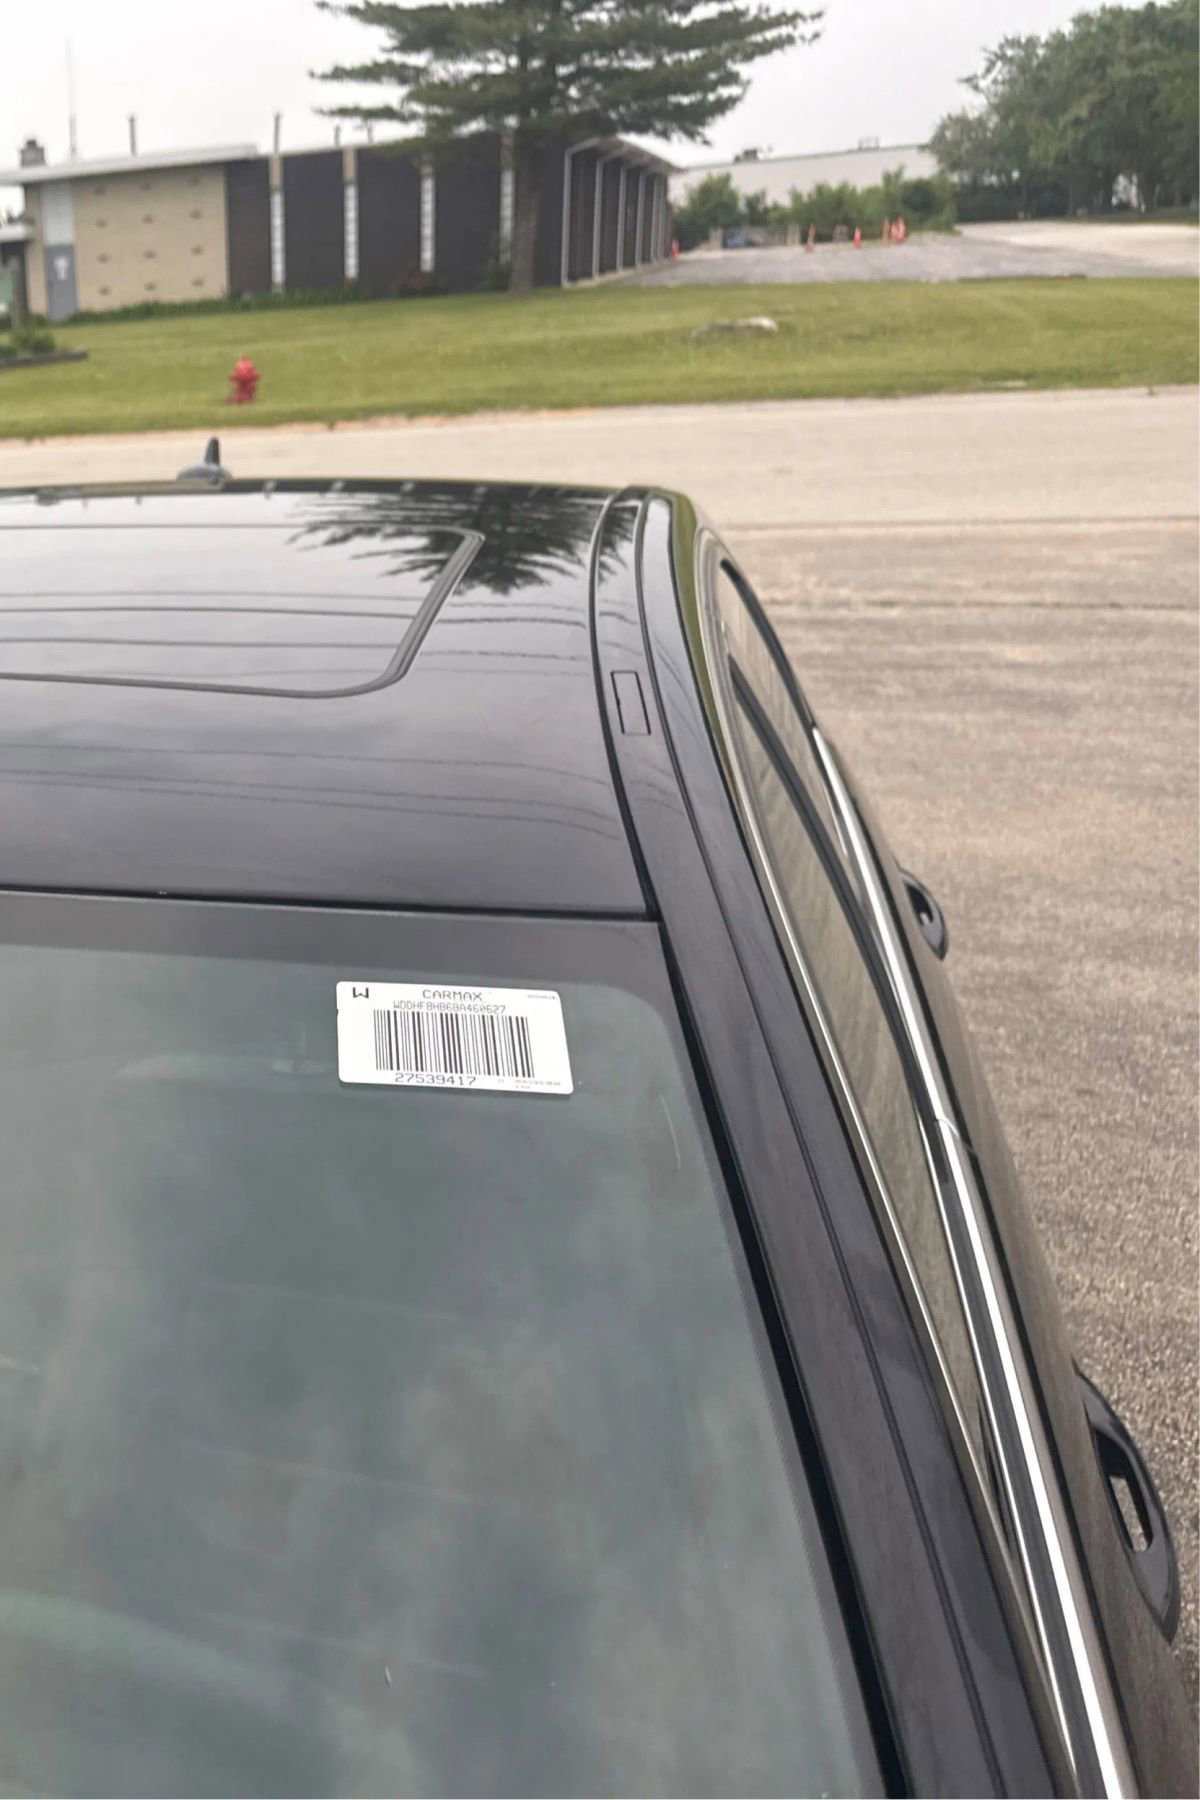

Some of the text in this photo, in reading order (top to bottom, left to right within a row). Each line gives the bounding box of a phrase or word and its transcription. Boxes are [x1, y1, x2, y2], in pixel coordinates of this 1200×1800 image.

[352, 987, 369, 998] W
[422, 989, 483, 1001] CARMAX
[394, 1072, 477, 1086] 27539417
